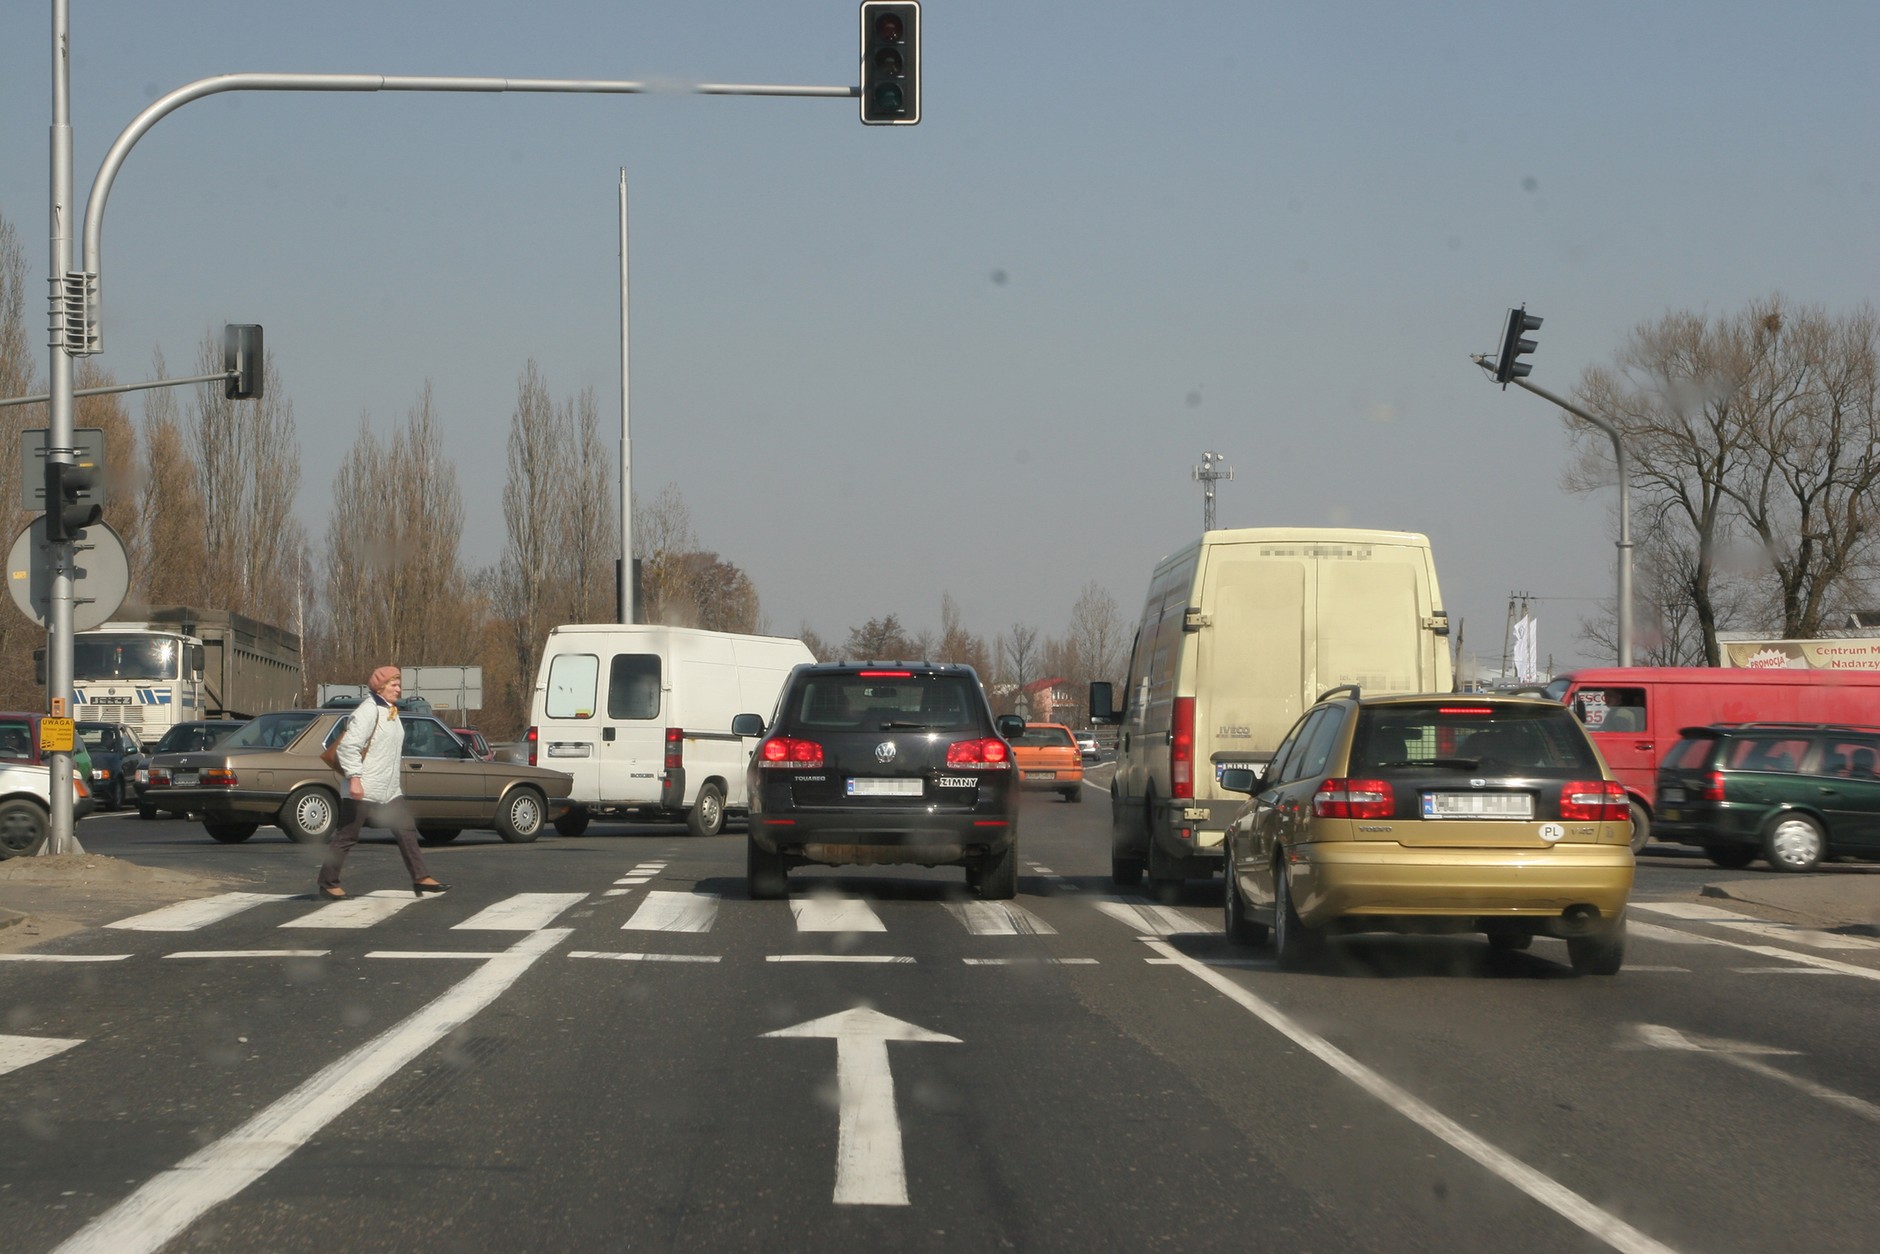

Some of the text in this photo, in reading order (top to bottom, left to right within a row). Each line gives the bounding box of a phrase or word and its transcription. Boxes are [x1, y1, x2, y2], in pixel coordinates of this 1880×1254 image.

[1816, 647, 1867, 655] Centrum
[1750, 656, 1785, 668] PROMOCJA
[940, 778, 978, 788] ZIMNY
[1545, 827, 1558, 836] PL
